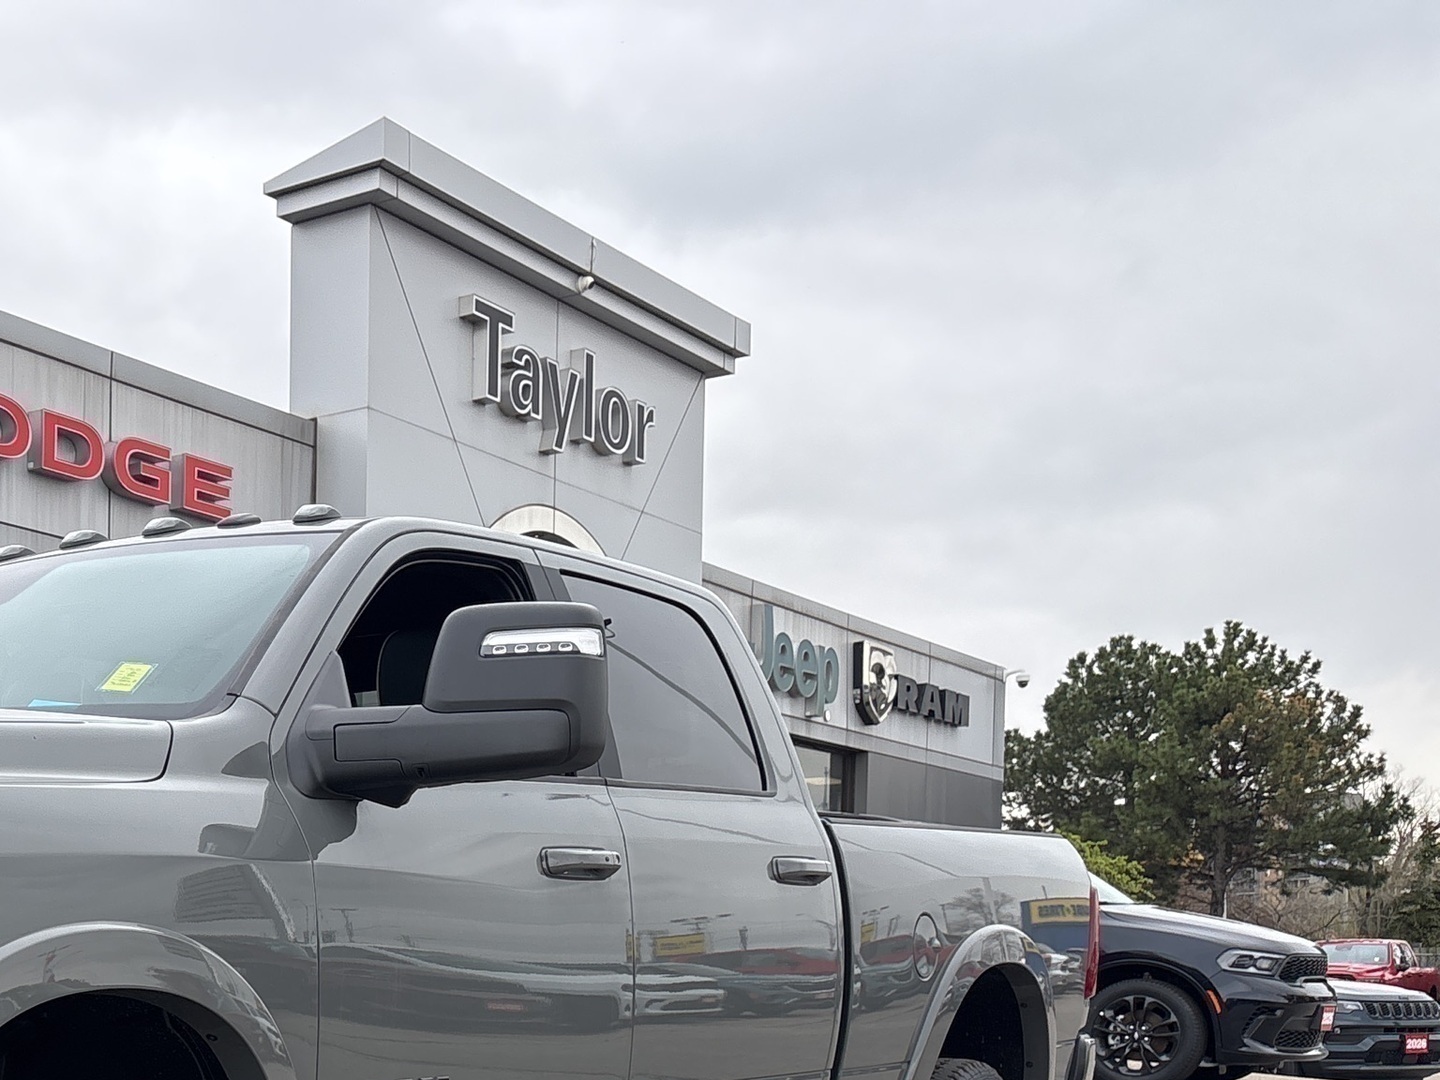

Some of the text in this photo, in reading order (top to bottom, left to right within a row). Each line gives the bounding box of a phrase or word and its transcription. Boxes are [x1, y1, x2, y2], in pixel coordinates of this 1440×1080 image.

[460, 293, 656, 465] Taylor
[751, 603, 840, 717] Jeep
[897, 674, 970, 727] RAM
